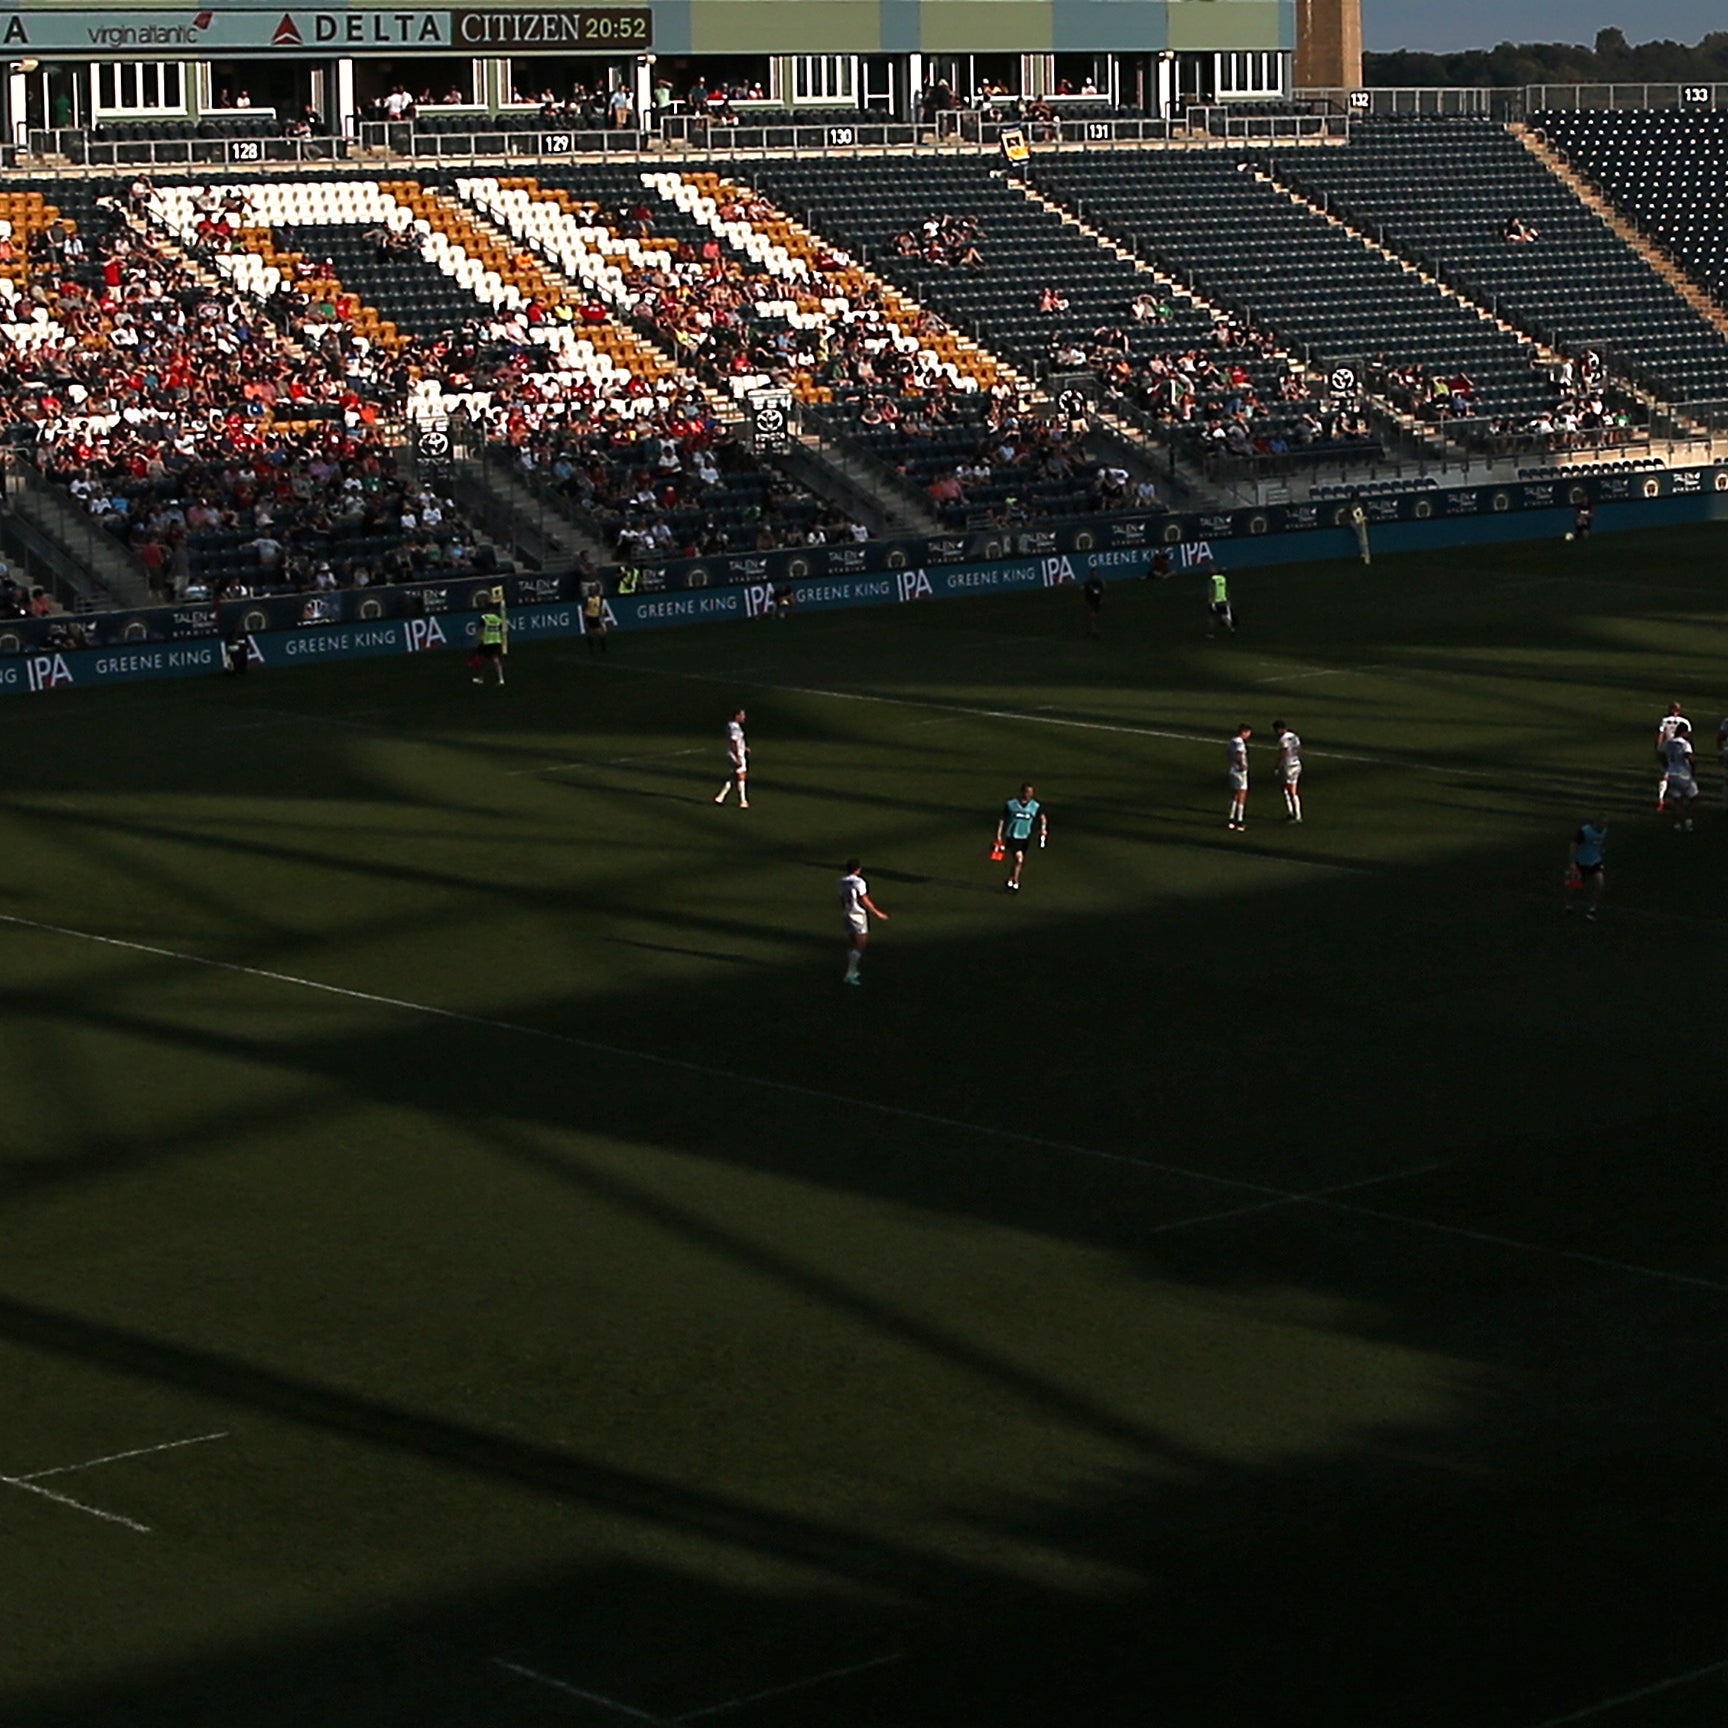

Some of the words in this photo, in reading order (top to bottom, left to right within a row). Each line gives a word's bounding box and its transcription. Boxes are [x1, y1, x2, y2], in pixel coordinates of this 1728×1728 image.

[316, 15, 441, 41] DELTA
[461, 13, 581, 43] CITIZEN
[585, 18, 647, 37] 20:52
[1350, 93, 1369, 108] 132
[1684, 87, 1709, 103] 133
[545, 135, 569, 152] 129
[830, 128, 852, 145] 130
[1089, 124, 1108, 140] 131
[232, 142, 258, 159] 128
[1088, 552, 1138, 568] GREENE
[1180, 540, 1214, 568] IPA
[947, 570, 998, 588] GREENE
[1003, 566, 1036, 582] KING
[1041, 554, 1076, 588] IPA
[796, 586, 850, 604] GREENE
[855, 581, 890, 597] KING
[896, 568, 934, 603] IPA
[466, 615, 526, 636] GNE
[531, 611, 570, 629] KING
[577, 598, 618, 635] IA
[637, 601, 694, 619] GREENE
[700, 595, 737, 612] KING
[285, 634, 349, 656] GREENE
[355, 629, 396, 647] KING
[404, 616, 448, 653] IPA
[96, 653, 163, 675] GREENE
[169, 649, 212, 667] KING
[220, 633, 265, 669] IA
[26, 652, 74, 692] IPA
